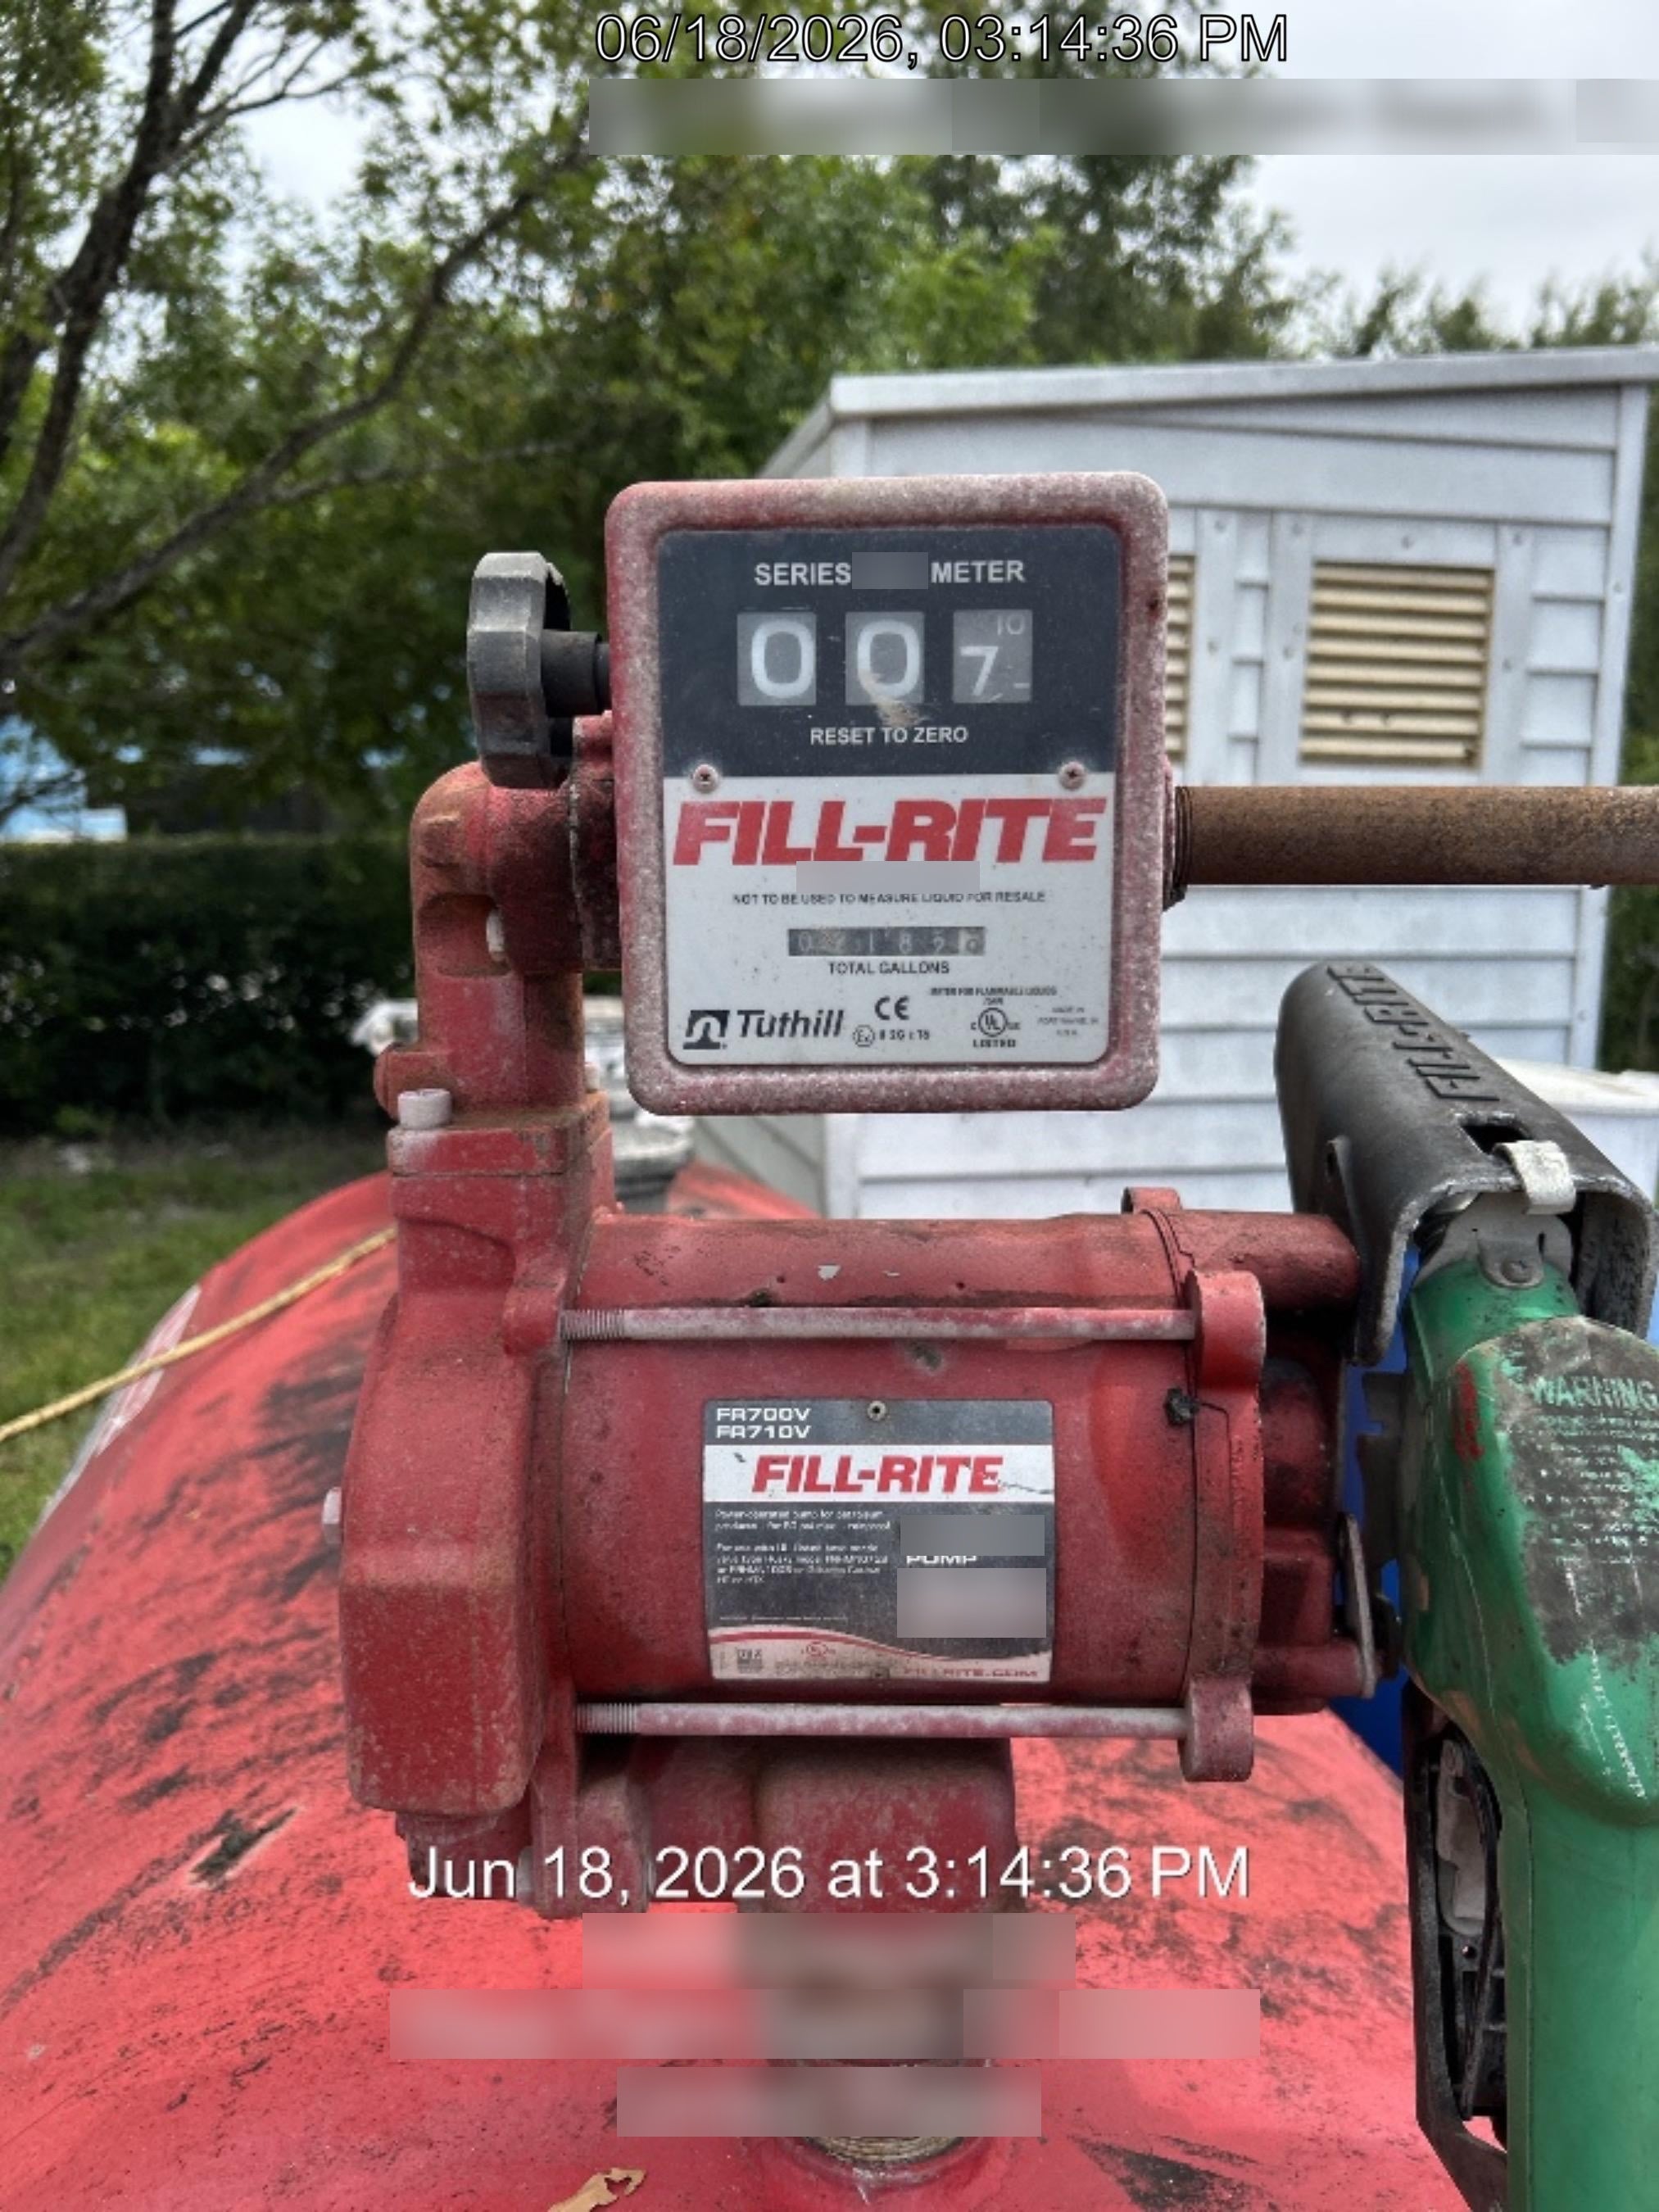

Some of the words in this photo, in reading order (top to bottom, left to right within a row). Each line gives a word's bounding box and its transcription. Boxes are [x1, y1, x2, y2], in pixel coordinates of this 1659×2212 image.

[755, 562, 852, 586] SERIES
[931, 560, 1027, 583] METER
[810, 727, 876, 746] RESET
[881, 727, 909, 745] TO
[913, 726, 968, 744] ZERO
[673, 797, 1107, 866] FILL-RITE
[762, 893, 778, 905] TO
[839, 893, 856, 904] TO
[995, 891, 1046, 903] RESALE
[828, 960, 876, 975] TOTAL
[879, 960, 950, 975] GALLONS
[737, 1009, 845, 1038] Tuthill
[751, 1454, 1004, 1495] FILL-RITE
[906, 1555, 977, 1566] PUMP
